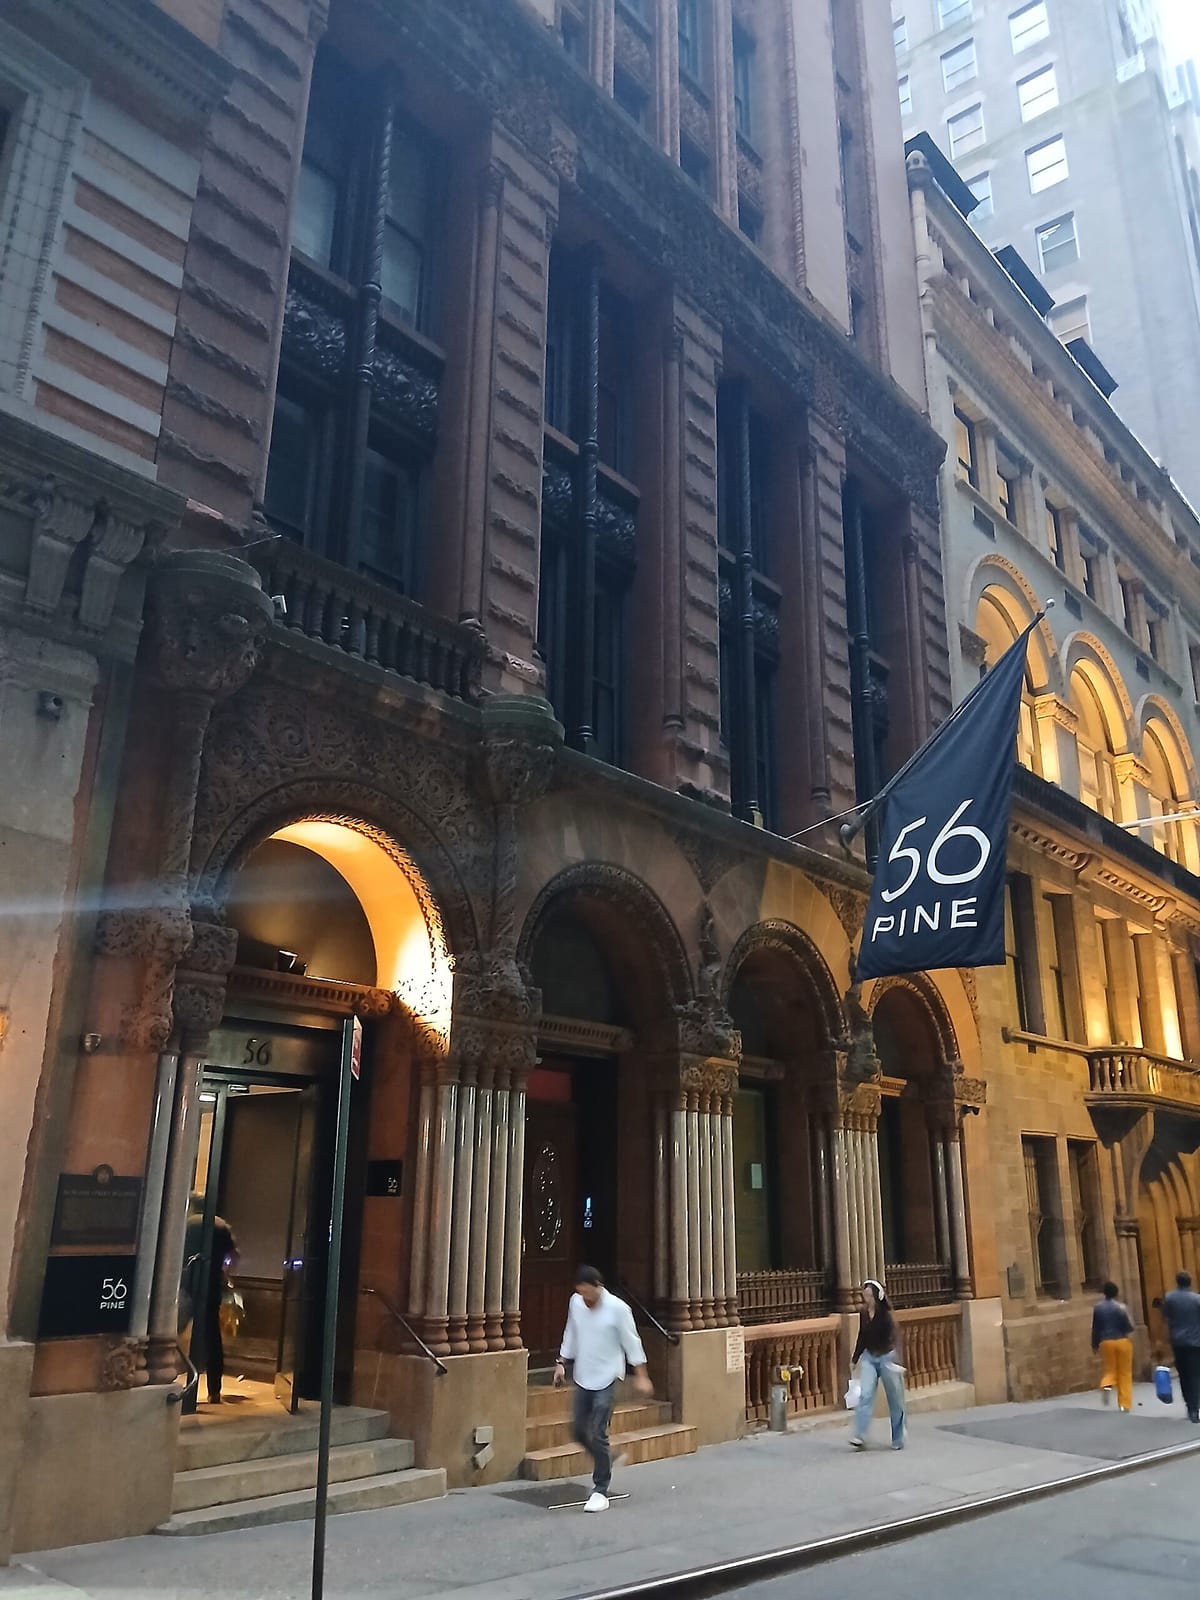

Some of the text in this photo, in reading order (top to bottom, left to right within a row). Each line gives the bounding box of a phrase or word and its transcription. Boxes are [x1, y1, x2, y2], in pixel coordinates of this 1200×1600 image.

[880, 799, 991, 903] 56
[871, 897, 978, 943] PINE
[243, 1038, 272, 1066] 56
[101, 1278, 127, 1300] 56
[100, 1301, 126, 1310] PINE
